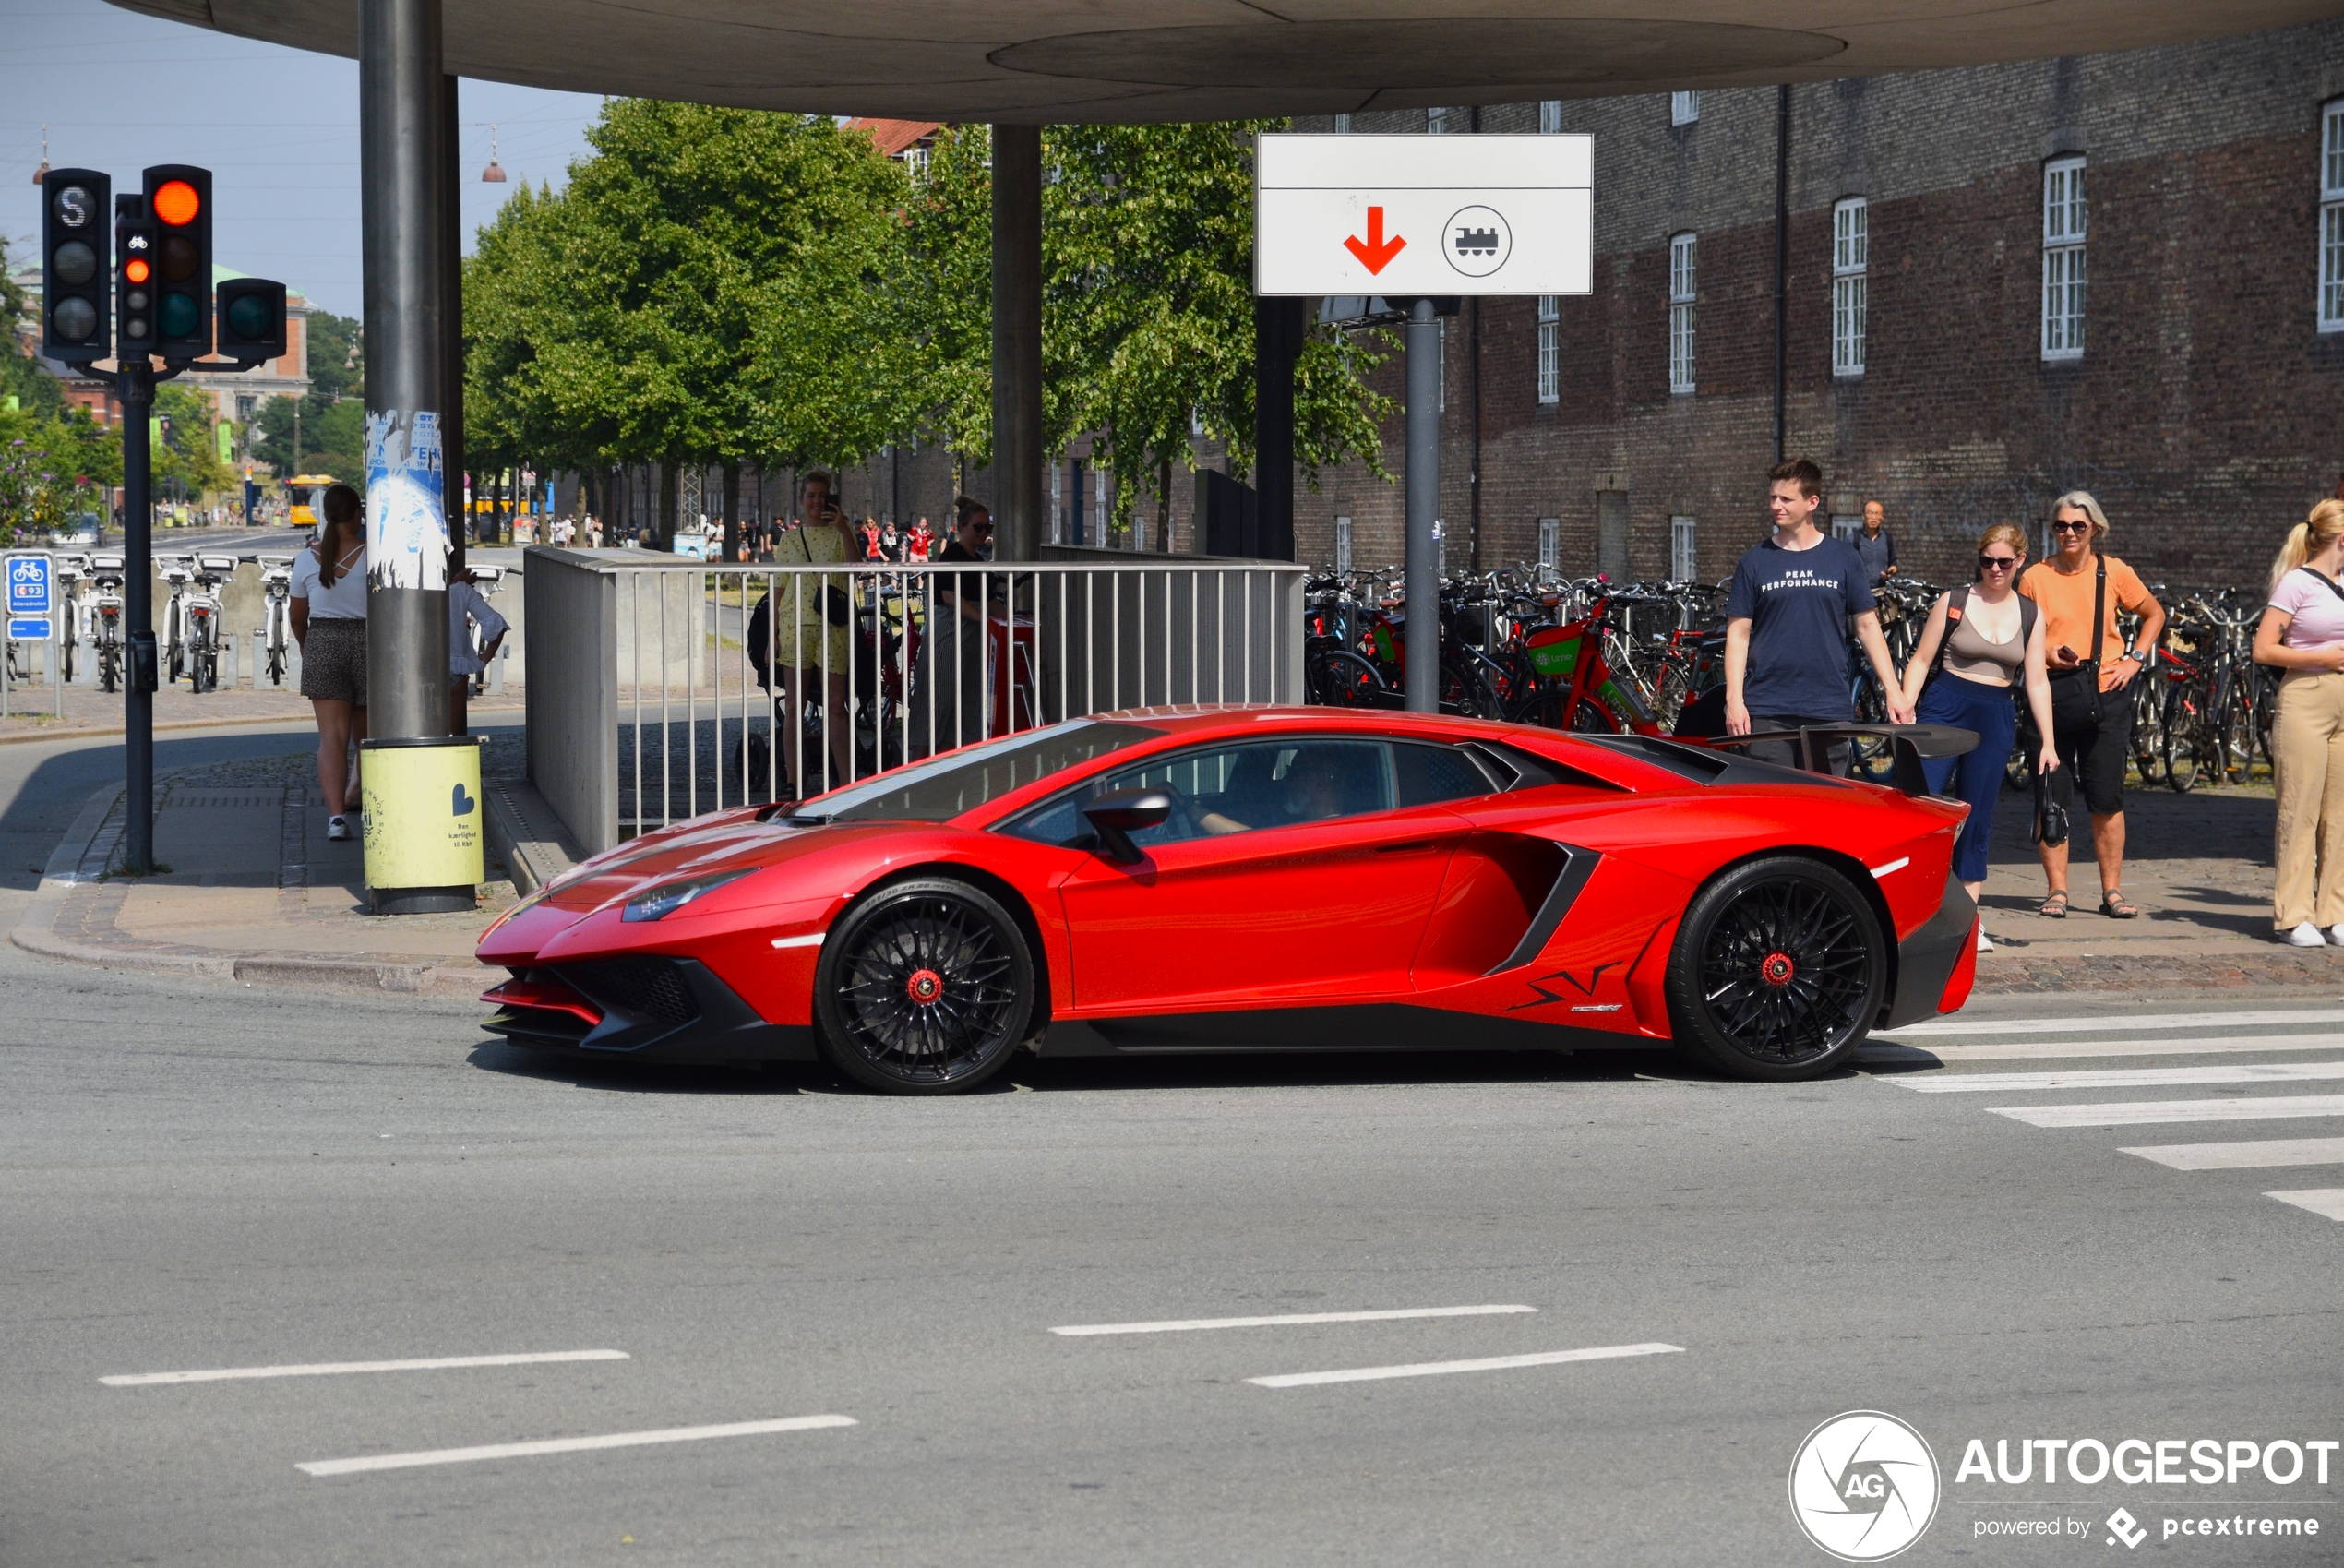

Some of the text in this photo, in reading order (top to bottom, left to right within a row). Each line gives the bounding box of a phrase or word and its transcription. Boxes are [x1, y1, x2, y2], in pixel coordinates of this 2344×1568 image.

[62, 187, 85, 226] S
[1785, 569, 1814, 579] PEAK
[1761, 578, 1839, 592] PERFORMANCE
